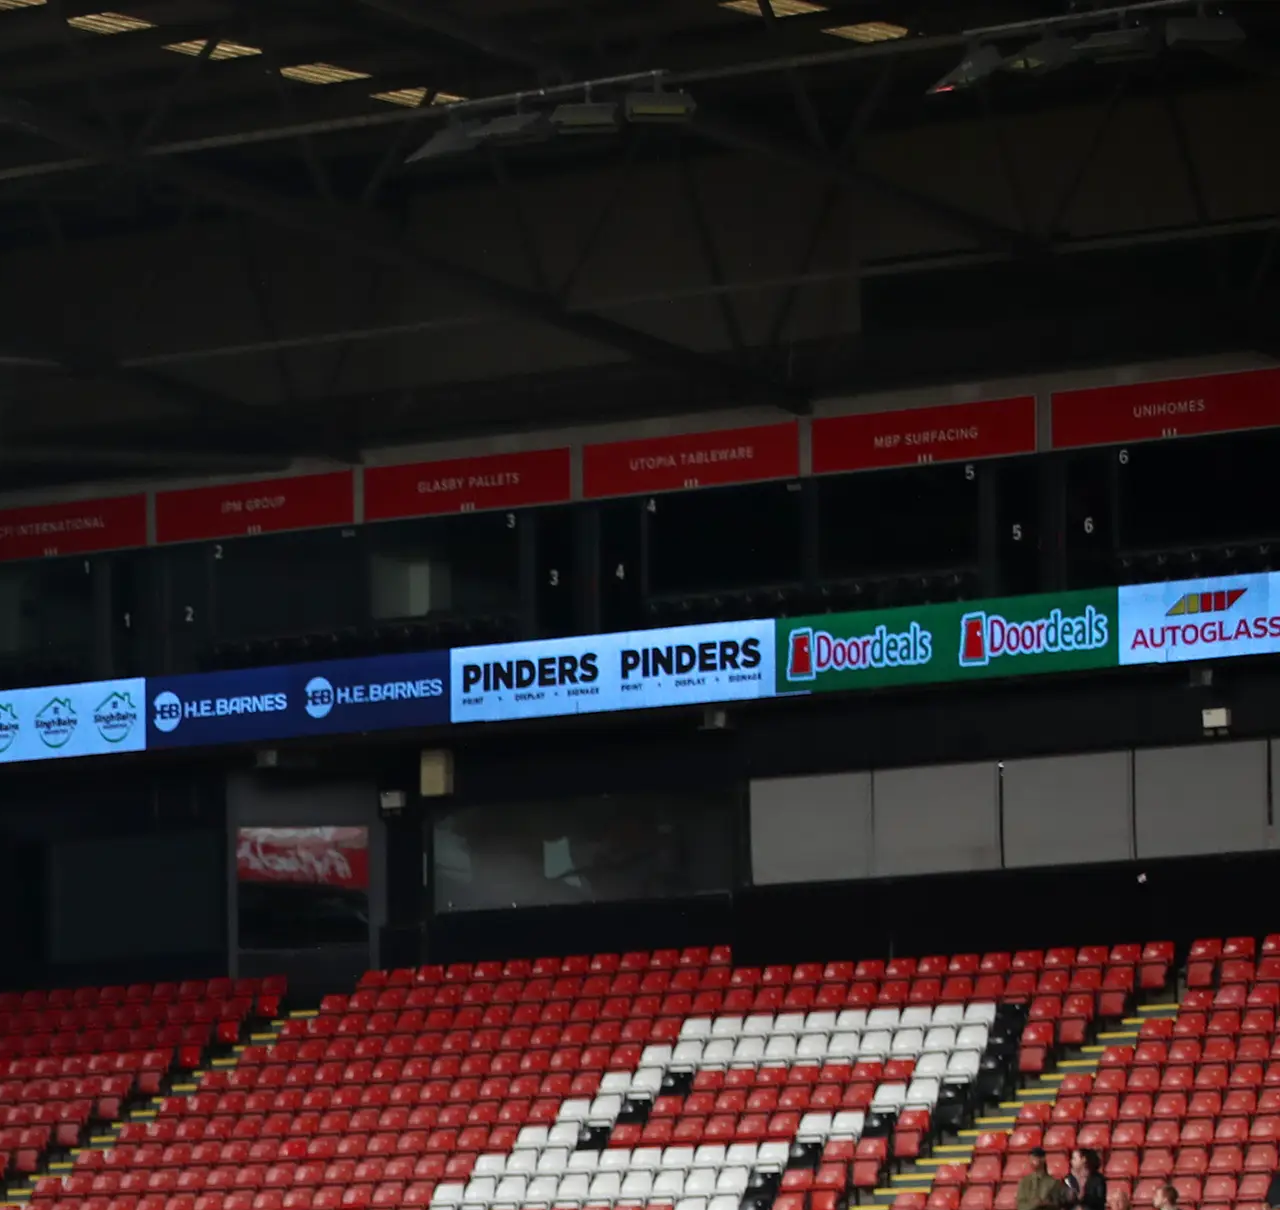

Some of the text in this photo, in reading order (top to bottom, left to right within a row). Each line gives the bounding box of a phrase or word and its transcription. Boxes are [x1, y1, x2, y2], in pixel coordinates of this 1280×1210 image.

[1133, 400, 1205, 418] UNIHOMES
[905, 427, 978, 446] SURFACING
[629, 446, 754, 471] UTOPIA TABLEWARE
[1119, 449, 1129, 464] 6
[965, 464, 975, 480] 5
[417, 472, 520, 494] GLASBY PALLETS
[245, 496, 285, 511] GROUP
[646, 498, 656, 513] 4
[506, 513, 516, 528] 3
[1084, 517, 1093, 533] 6
[1012, 524, 1022, 541] 5
[214, 544, 223, 559] 2
[549, 569, 558, 586] 3
[615, 563, 624, 580] 4
[124, 612, 131, 628] 1
[185, 606, 194, 622] 2
[989, 606, 1108, 656] Doordeals
[1131, 616, 1280, 650] AUTOGLASS
[815, 622, 931, 670] Doordeals
[620, 638, 762, 680] PINDERS
[462, 653, 599, 693] PINDERS
[336, 678, 444, 704] H.E.BARNES
[184, 693, 288, 718] H.E.BARNES
